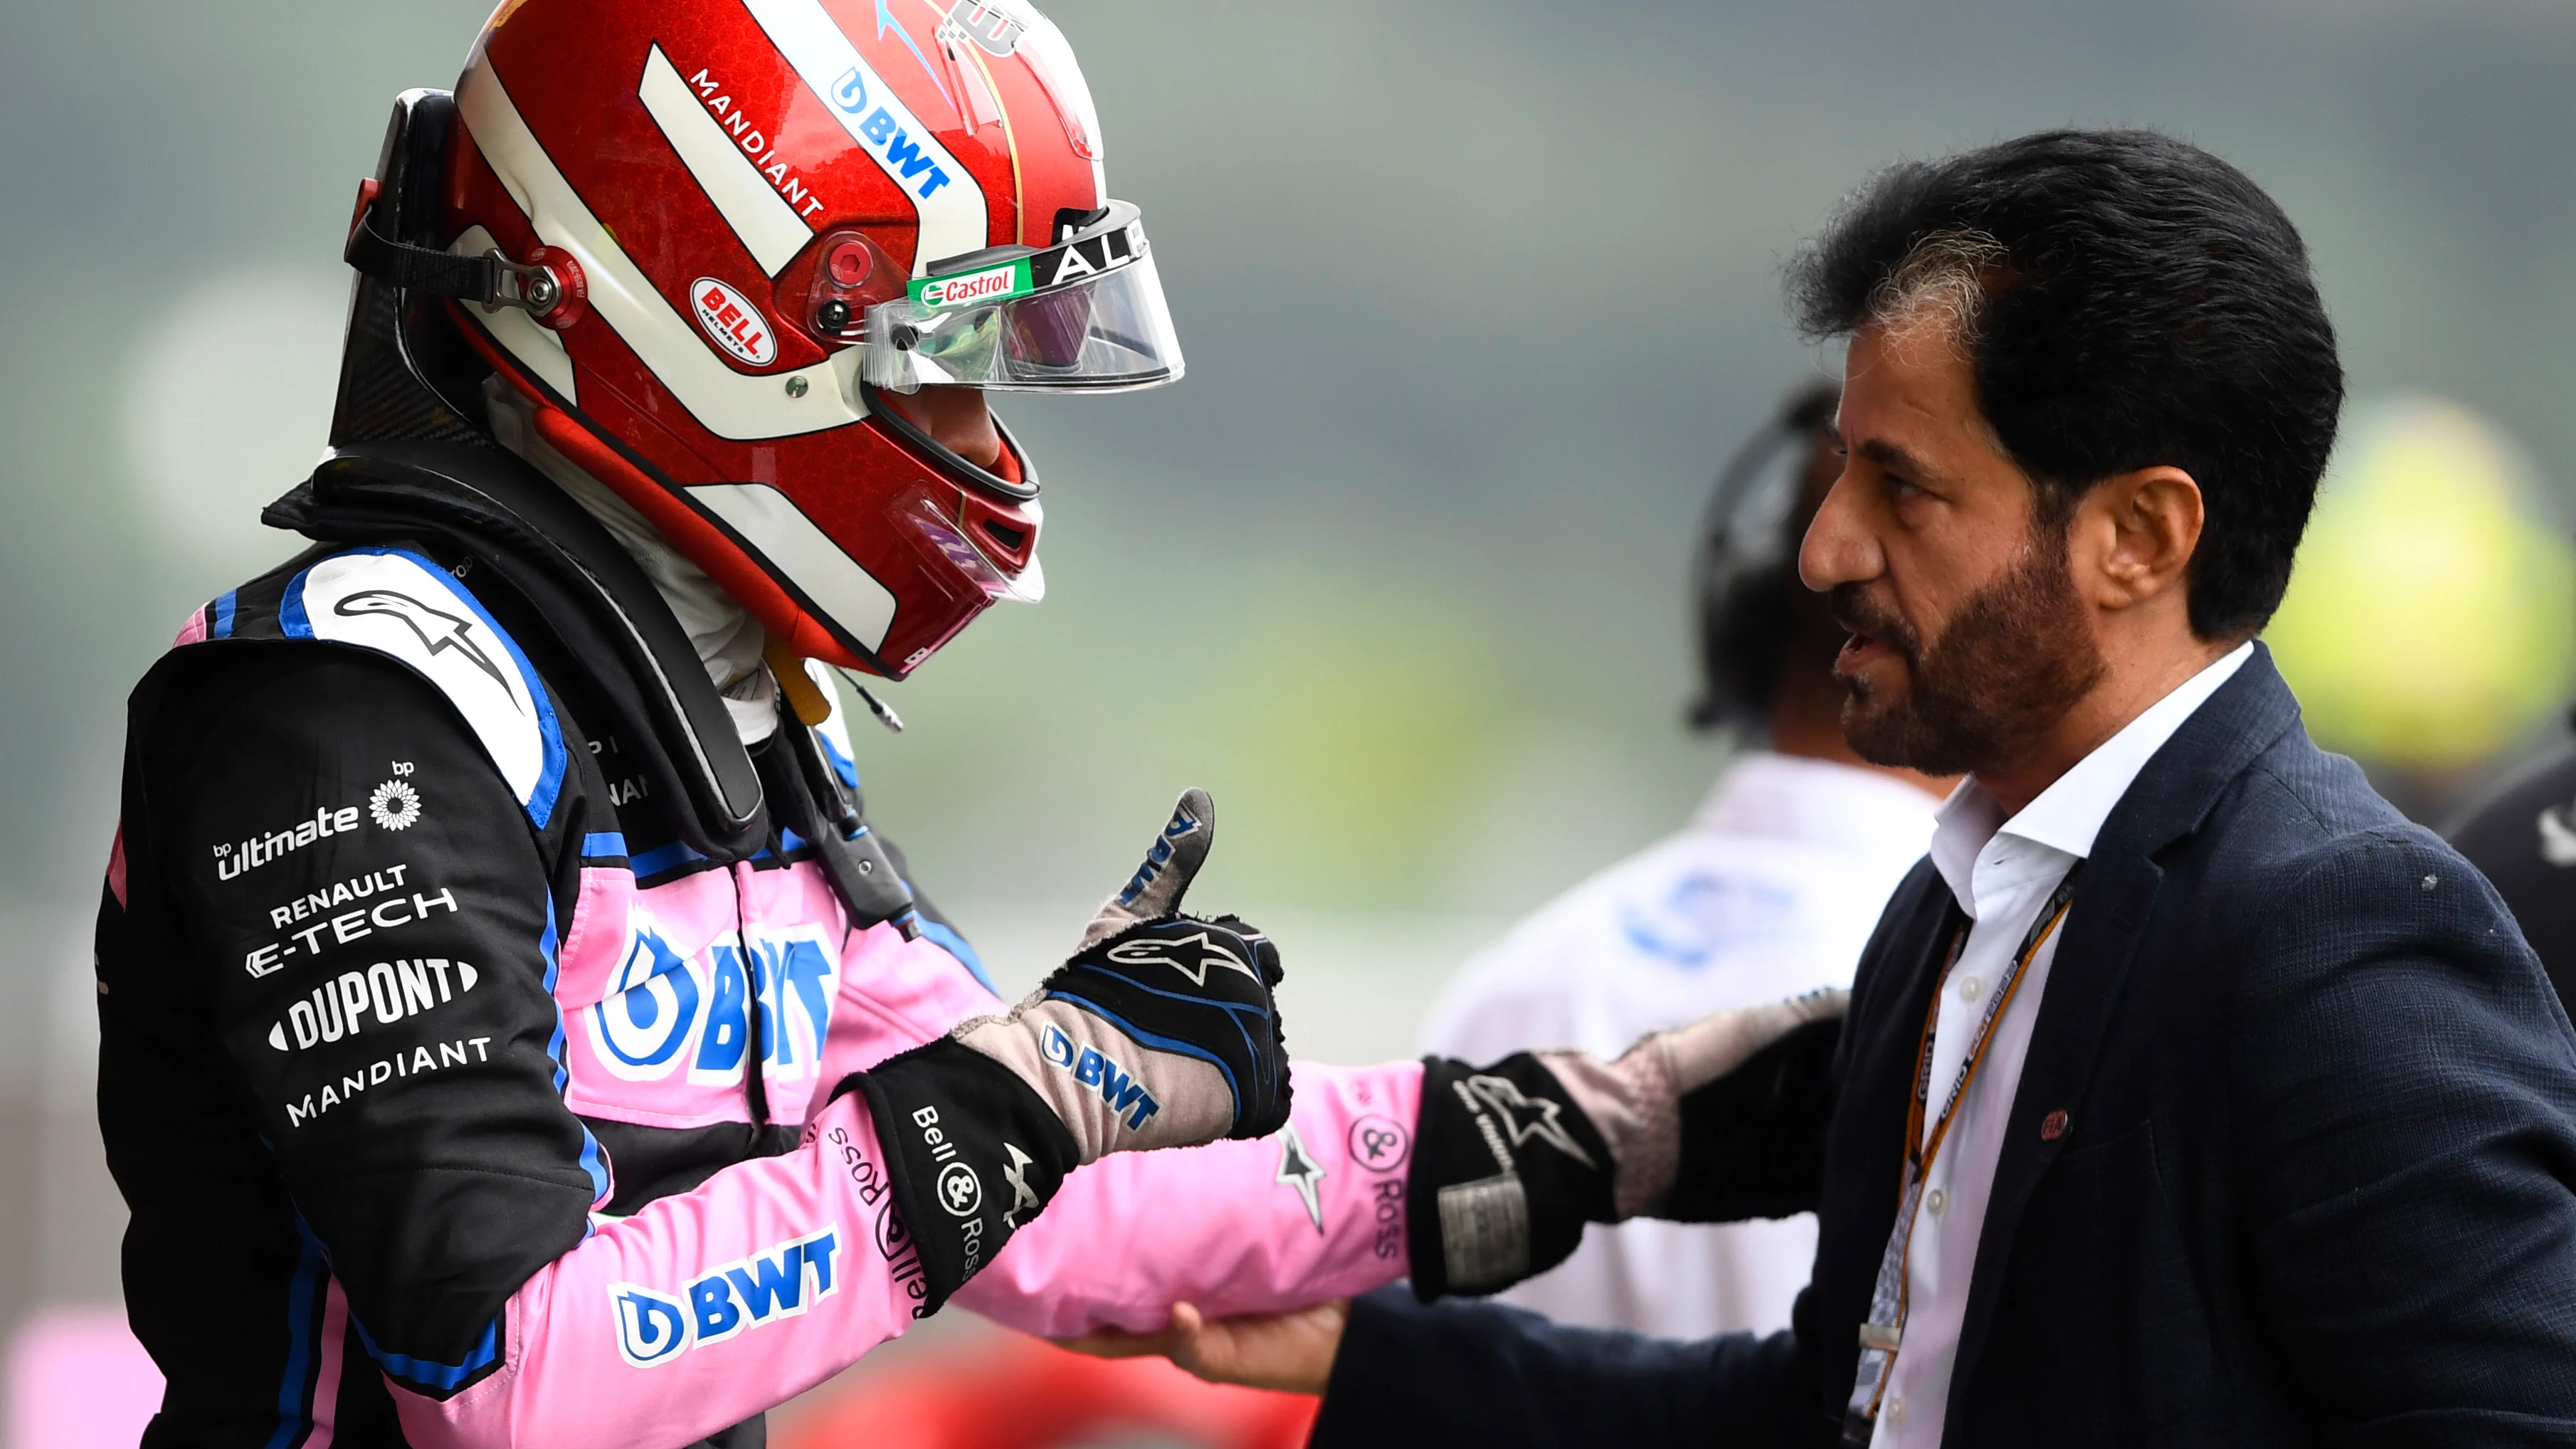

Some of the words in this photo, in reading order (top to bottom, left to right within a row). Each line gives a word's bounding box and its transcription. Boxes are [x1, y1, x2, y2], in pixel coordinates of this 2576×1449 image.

[690, 69, 823, 216] MANDIANT
[860, 106, 951, 199] BWT
[702, 287, 762, 355] BELL
[946, 270, 1010, 302] Castrol
[702, 310, 744, 353] HELMETS
[392, 761, 414, 776] bp
[213, 843, 231, 858] bp
[218, 806, 359, 880] ultimate
[270, 864, 406, 929] RENAULT
[246, 888, 457, 979] E-TECH
[288, 959, 452, 1050] DUPONT
[286, 1038, 490, 1127] MANDIANT
[1076, 1048, 1158, 1130] BWT
[912, 1105, 956, 1161] Bell
